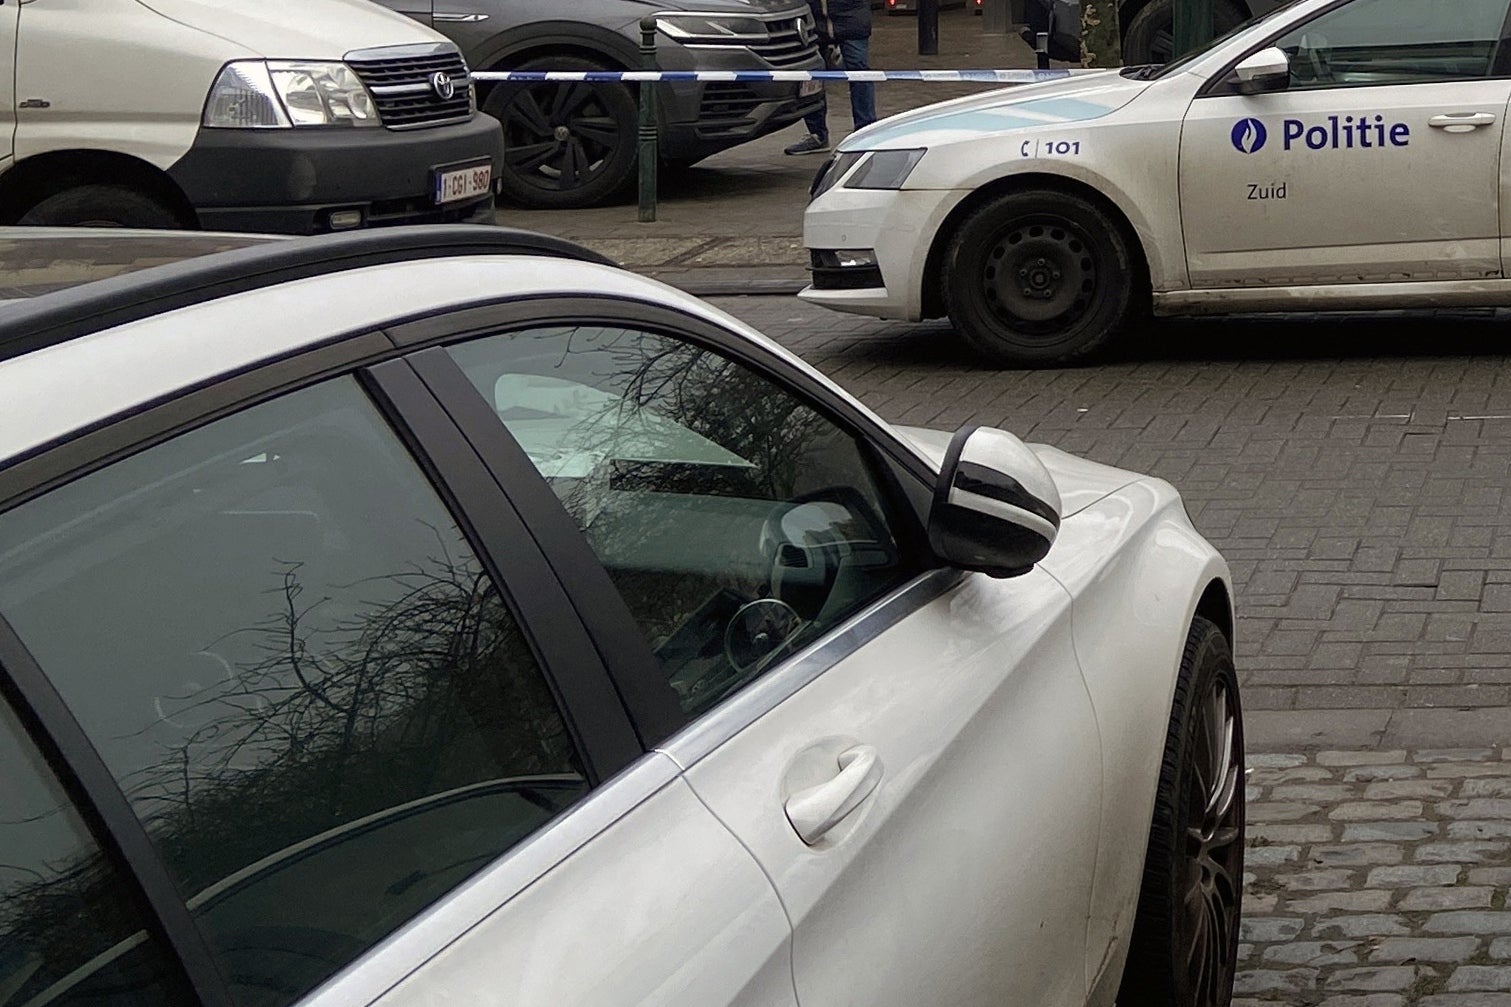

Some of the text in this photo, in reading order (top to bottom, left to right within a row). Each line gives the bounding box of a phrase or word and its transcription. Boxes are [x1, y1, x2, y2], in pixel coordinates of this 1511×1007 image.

[1283, 115, 1410, 151] Politie
[1045, 141, 1080, 155] 101
[1247, 183, 1287, 200] Zuid
